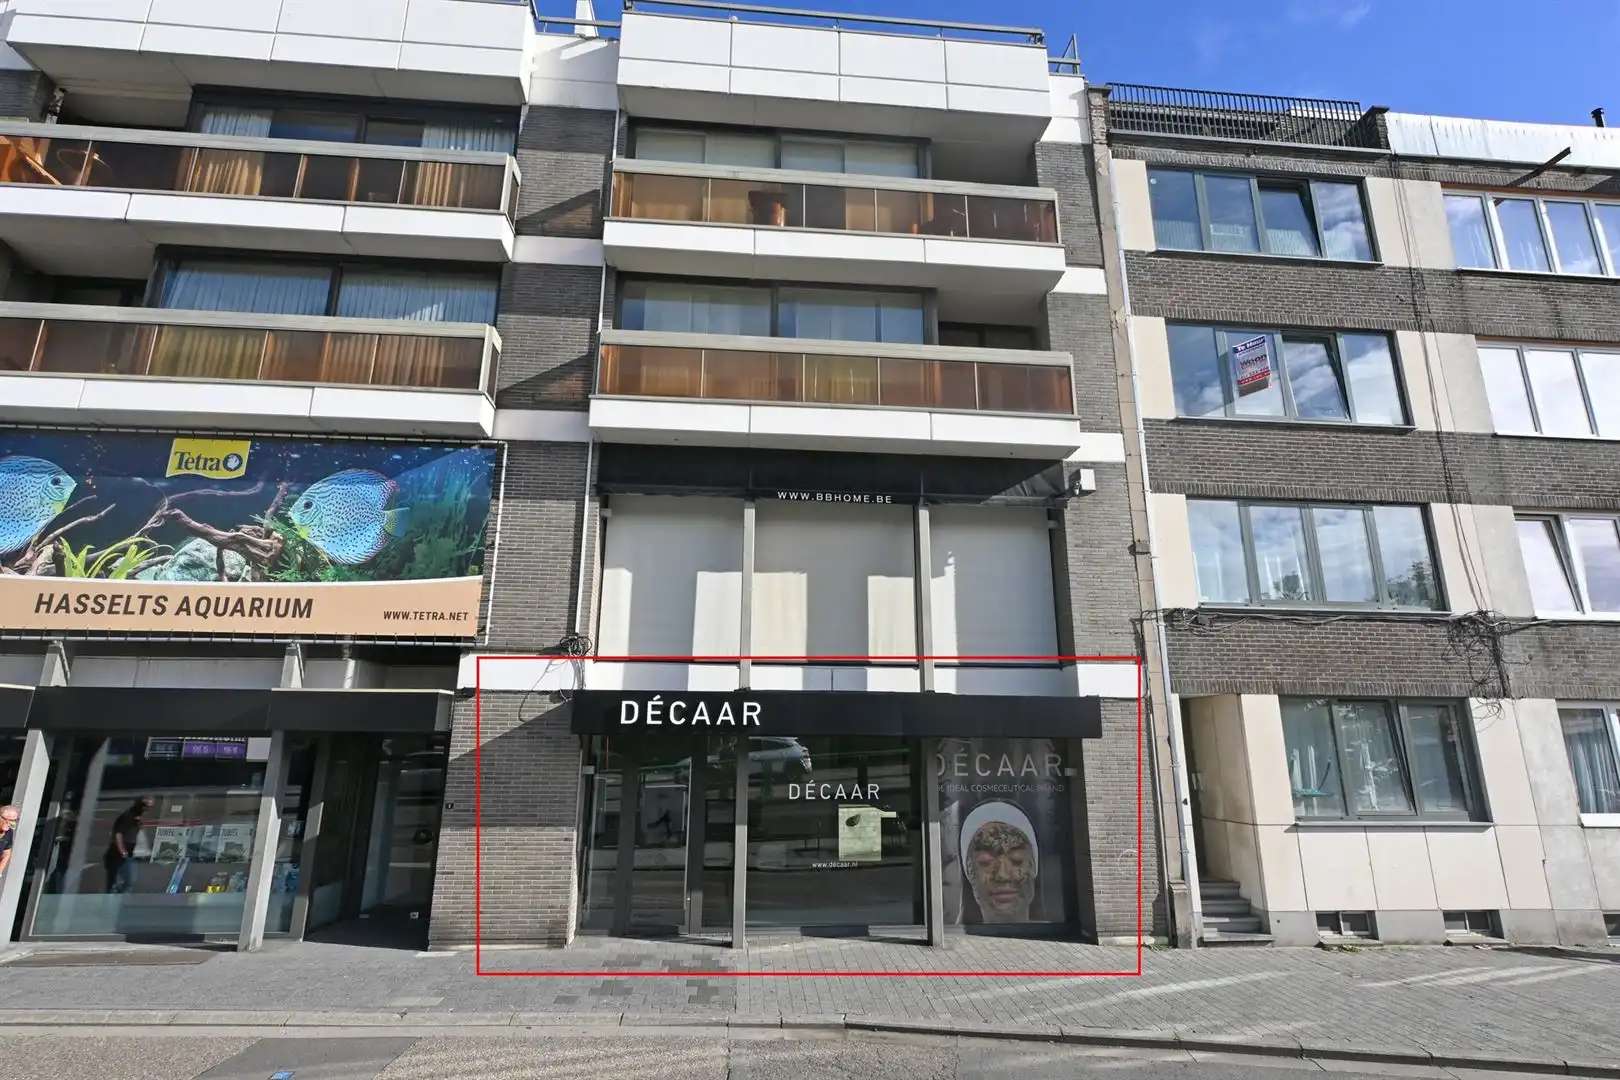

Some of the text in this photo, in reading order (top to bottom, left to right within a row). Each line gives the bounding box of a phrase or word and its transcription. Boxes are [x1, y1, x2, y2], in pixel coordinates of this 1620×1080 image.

[174, 451, 221, 471] Tetra
[777, 491, 892, 504] WWW.BBHOME.BE
[34, 593, 314, 619] HASSELTS AQUARIUM
[383, 610, 469, 621] WWW.TETRA.NET
[620, 694, 762, 726] DÉCAAR
[789, 780, 880, 800] DÉCAAR
